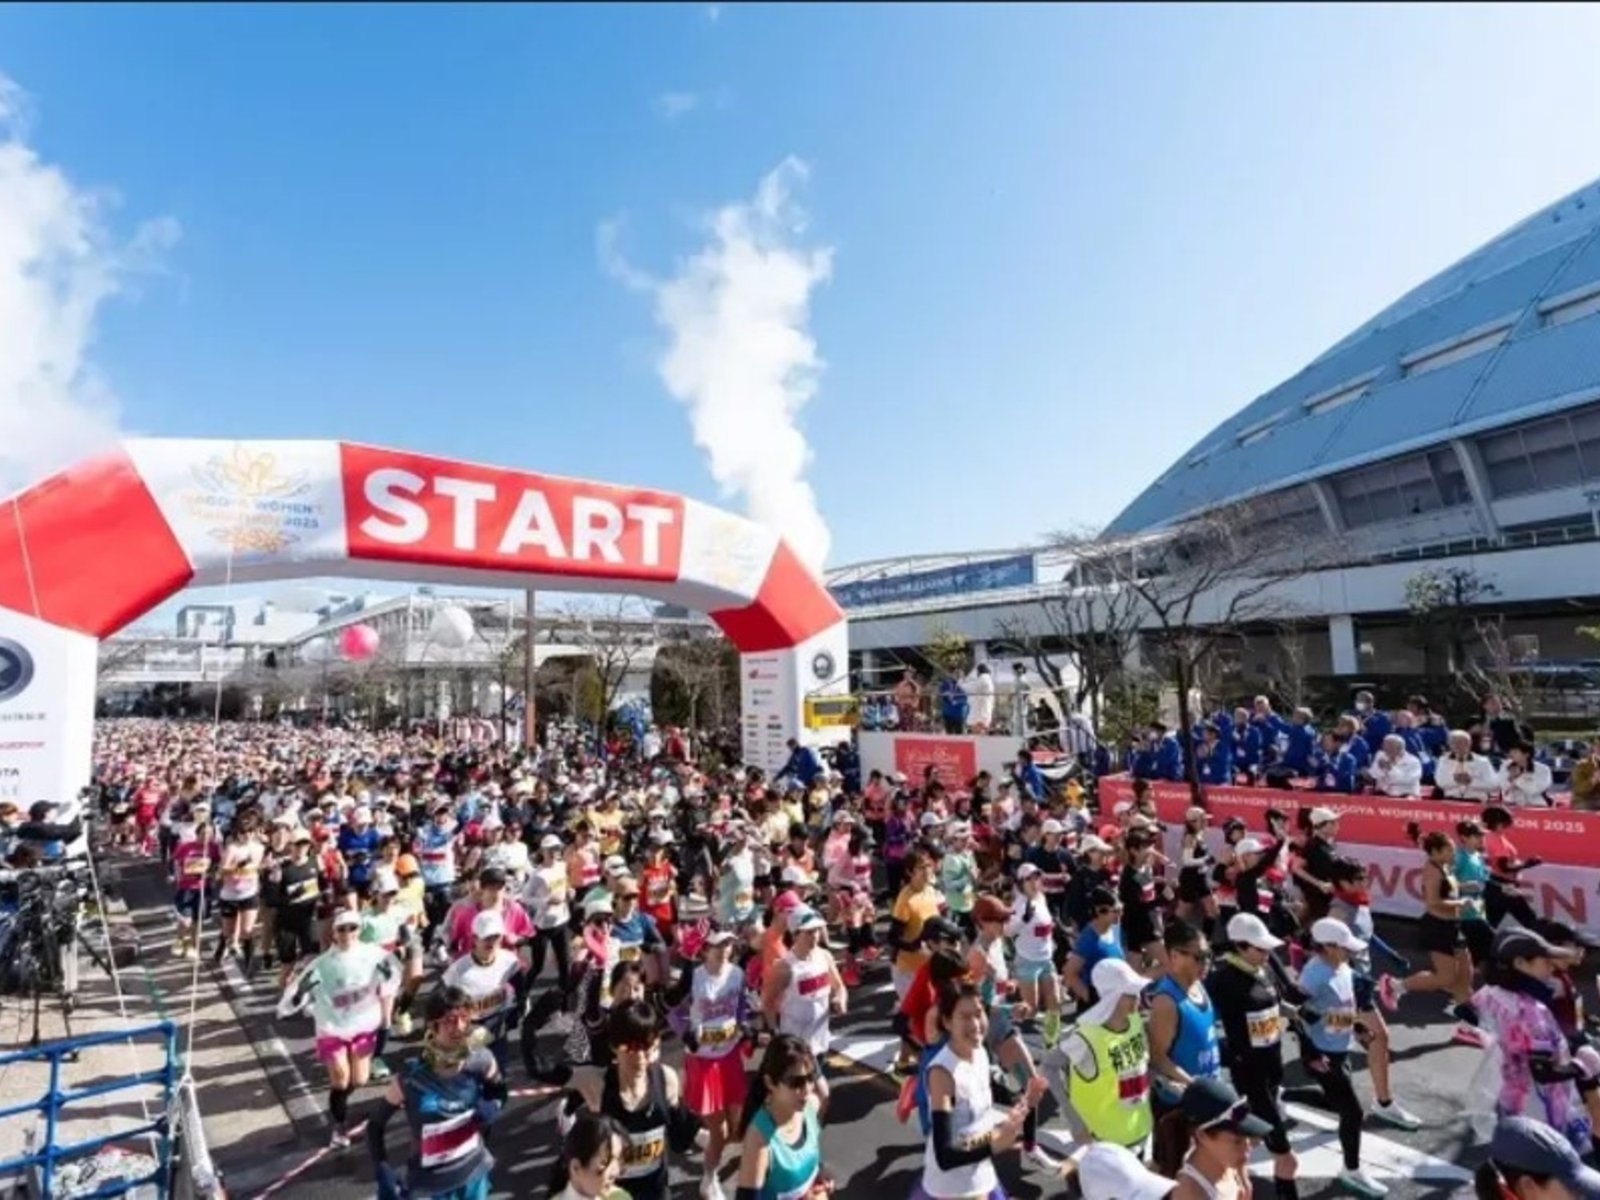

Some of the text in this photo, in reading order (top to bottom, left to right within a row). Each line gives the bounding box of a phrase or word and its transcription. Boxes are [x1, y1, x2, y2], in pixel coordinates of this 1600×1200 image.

[283, 517, 319, 529] 2025
[359, 467, 674, 566] START
[1207, 793, 1268, 807] MARATHON
[1377, 807, 1446, 822] WOMEN'S
[1543, 821, 1586, 834] 2025
